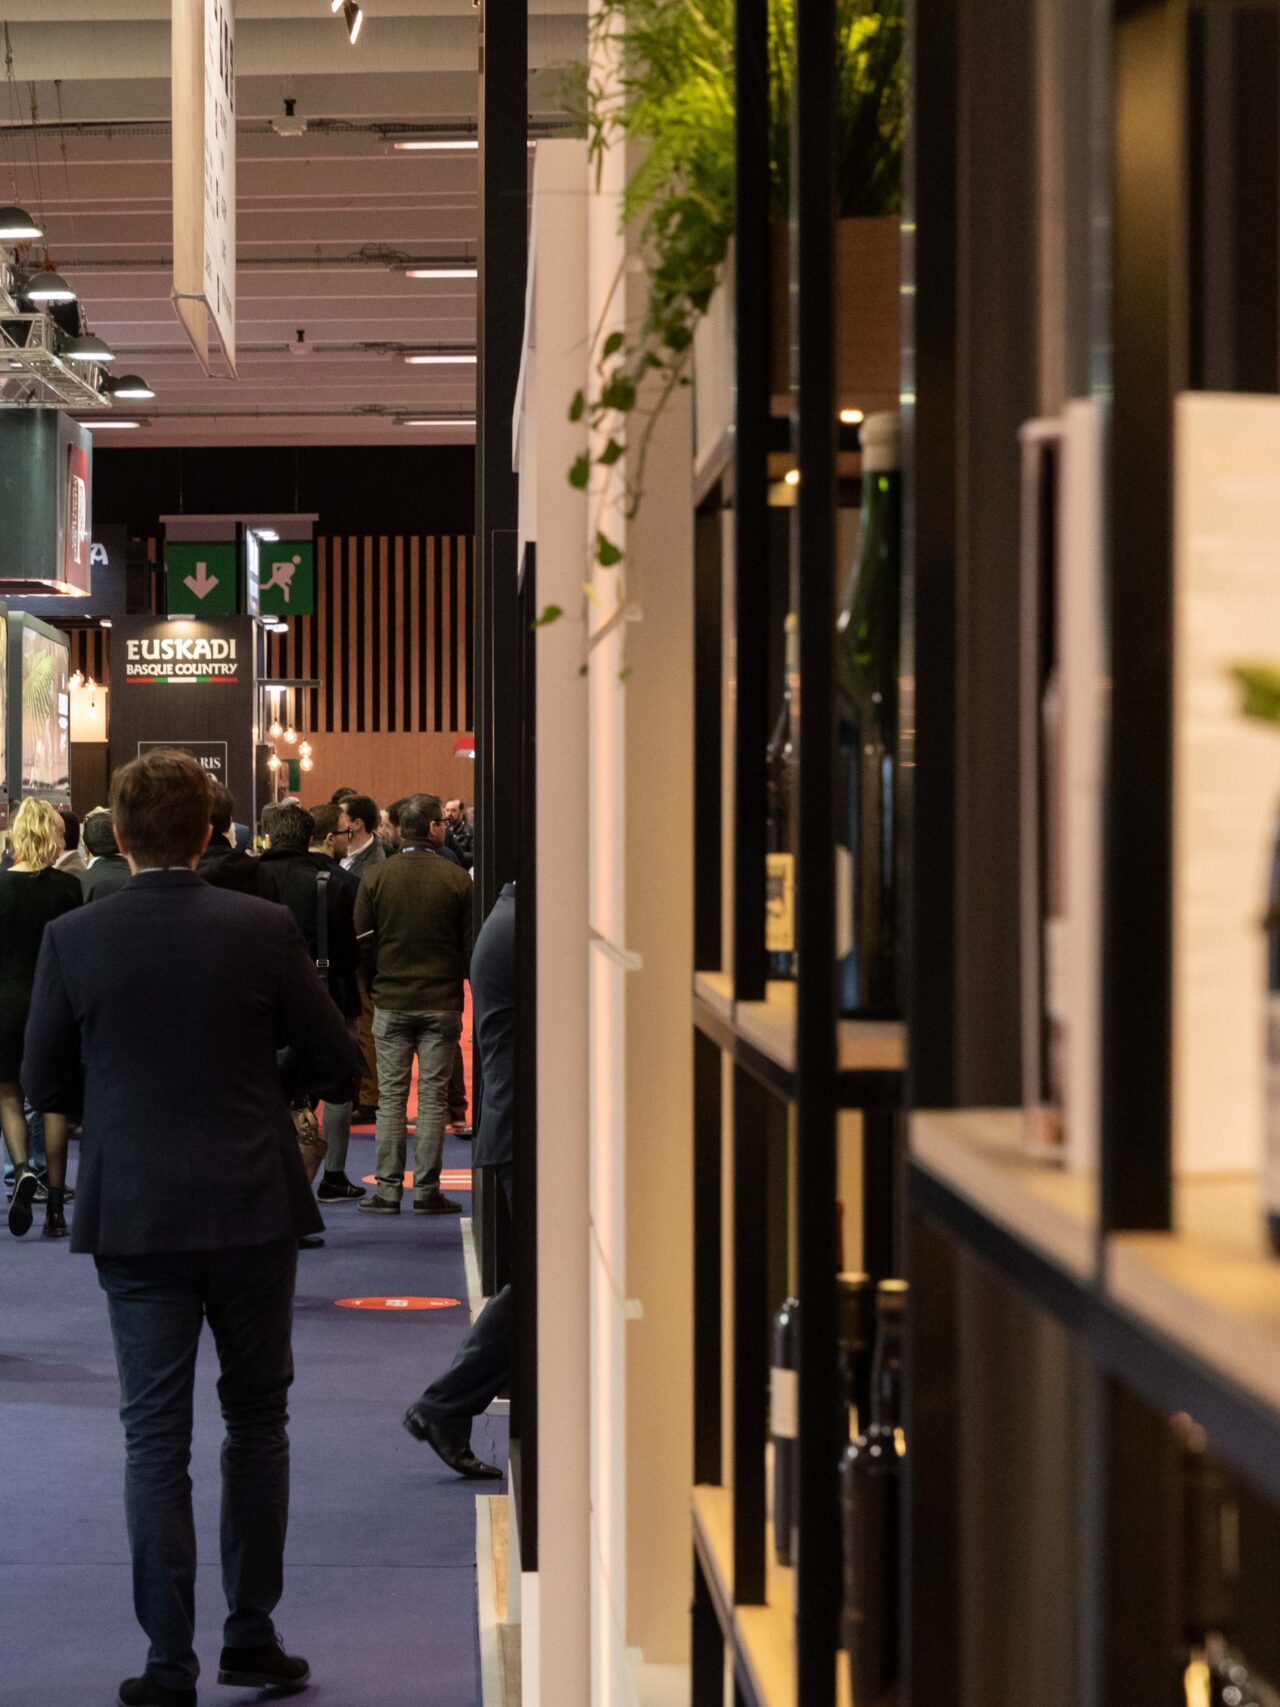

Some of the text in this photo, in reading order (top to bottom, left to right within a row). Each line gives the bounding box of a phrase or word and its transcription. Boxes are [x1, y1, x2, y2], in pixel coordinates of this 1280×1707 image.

[126, 639, 236, 660] EUSKADI
[126, 663, 238, 676] BASQUE COUNTRY
